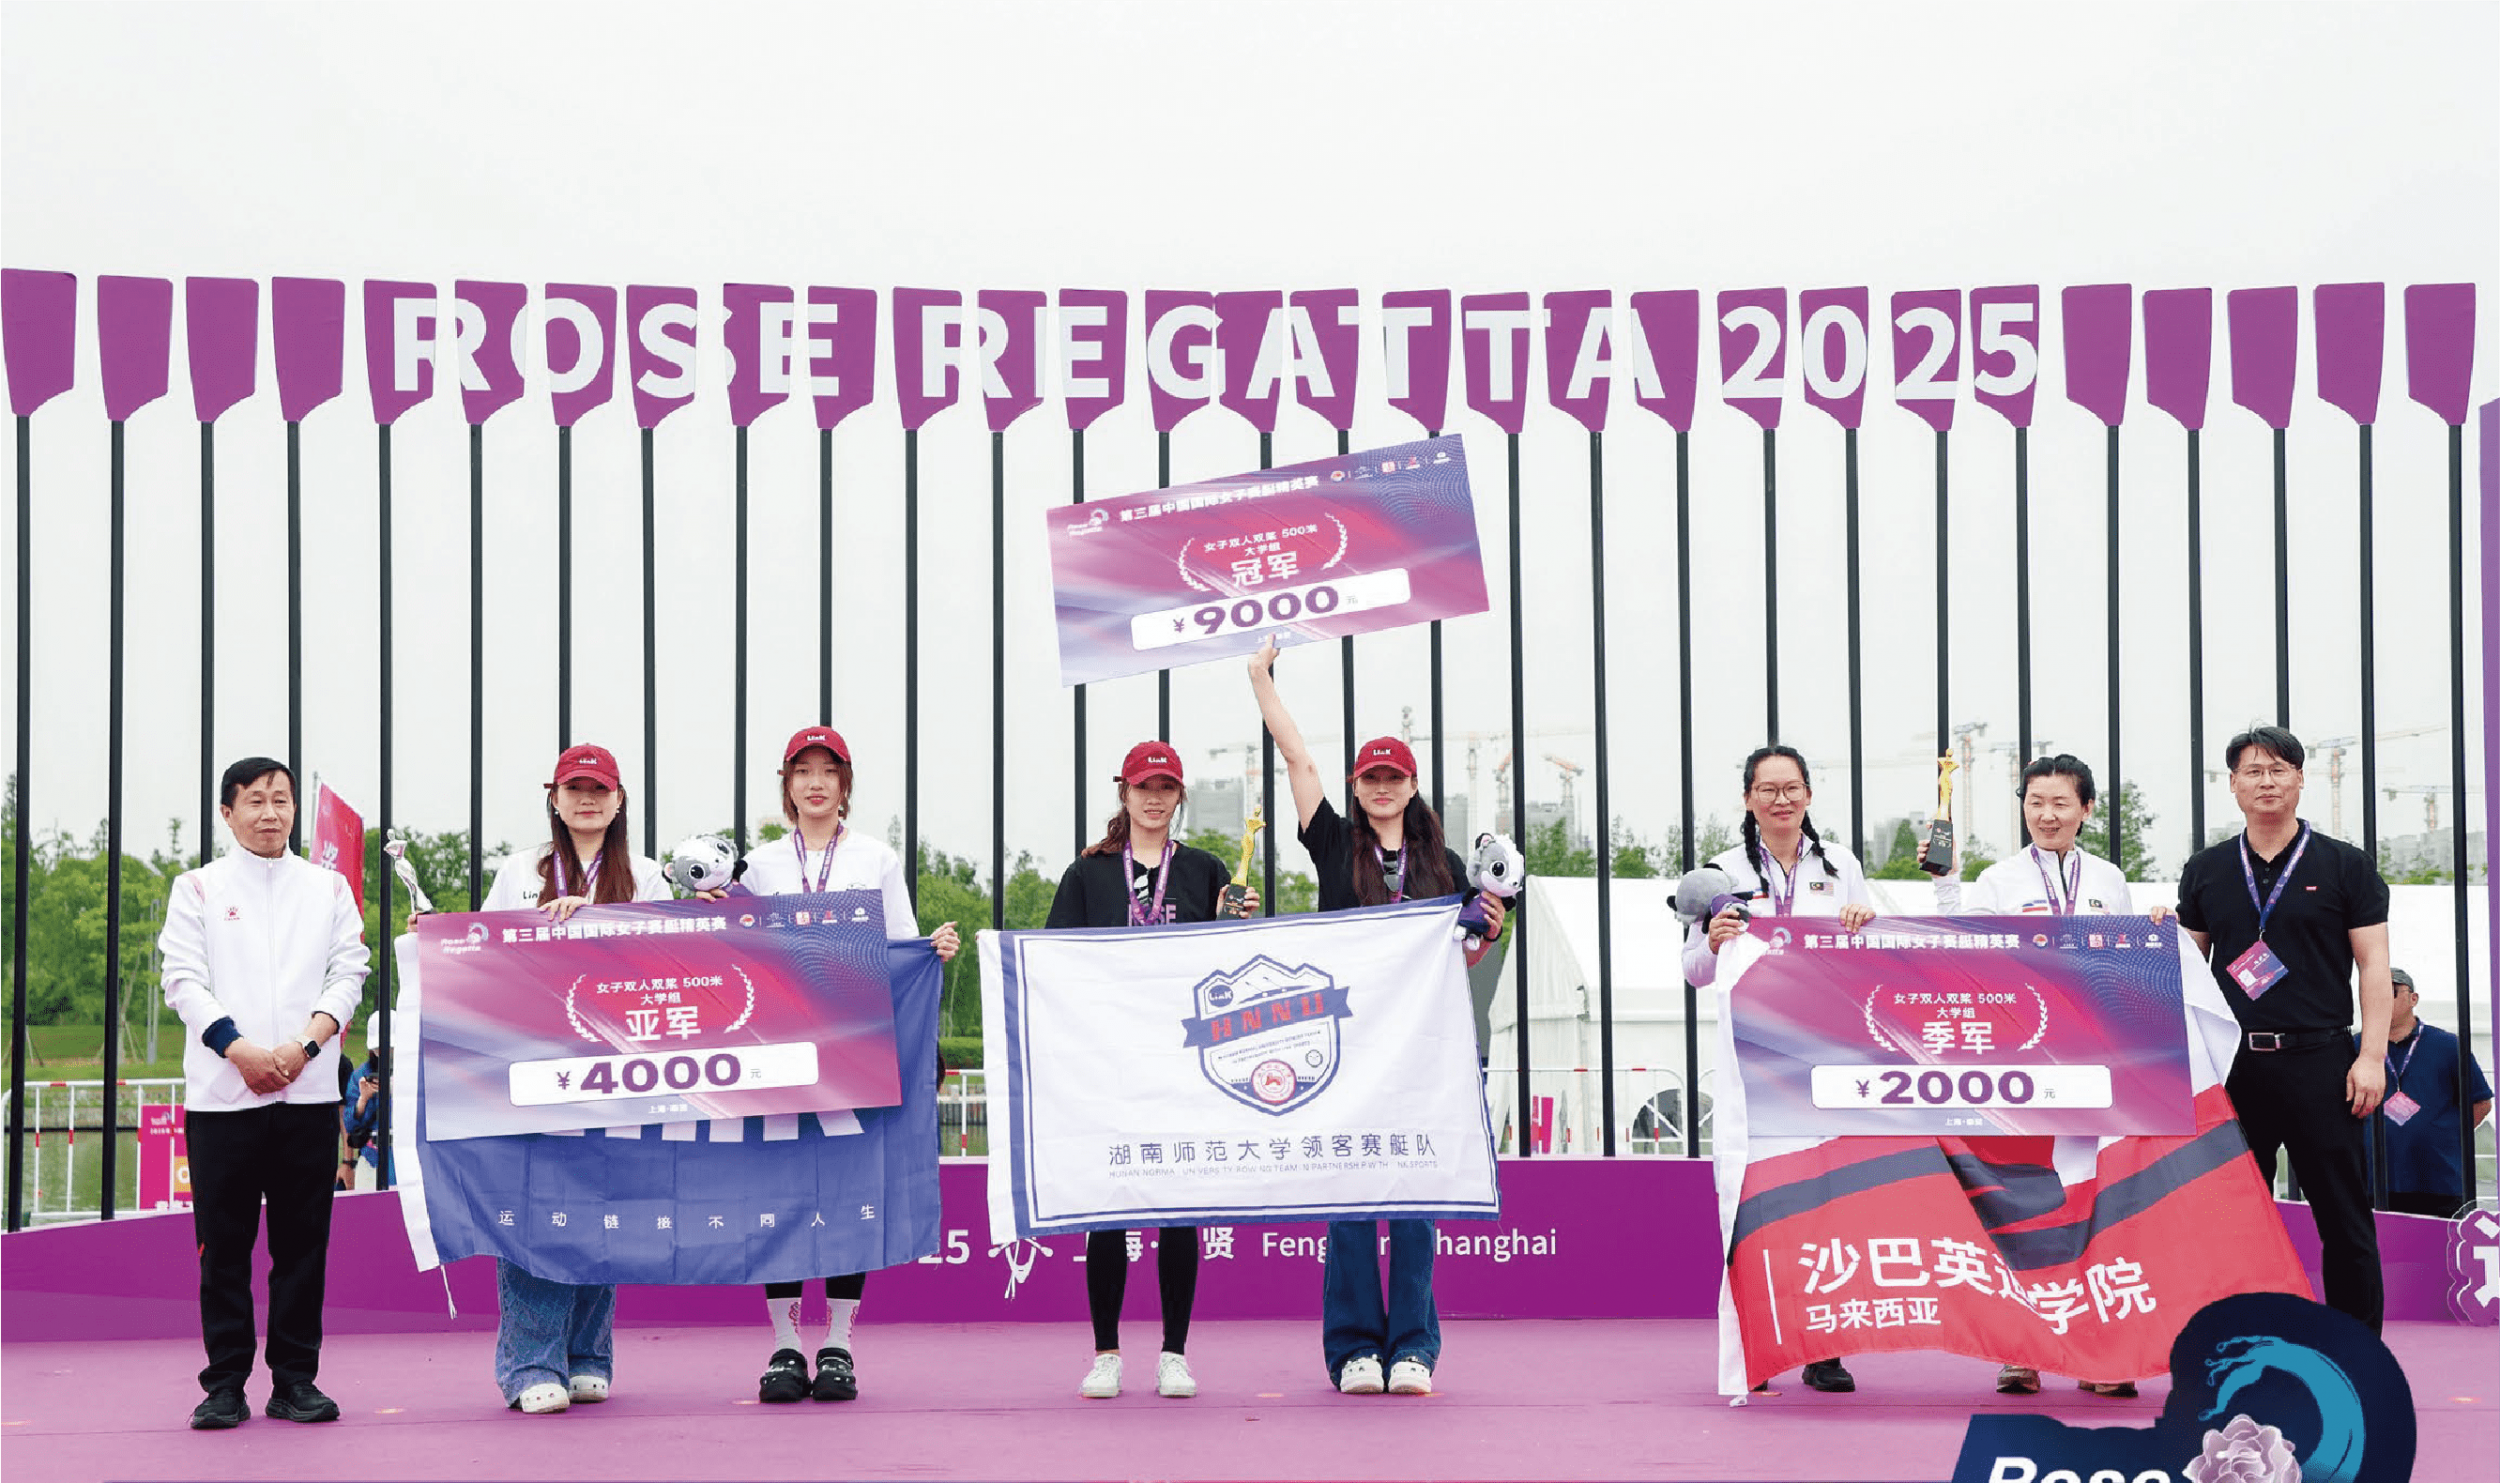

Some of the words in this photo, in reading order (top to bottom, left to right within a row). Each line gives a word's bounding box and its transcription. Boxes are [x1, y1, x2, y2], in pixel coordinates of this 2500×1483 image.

[393, 297, 840, 398] ROSE
[921, 303, 1667, 401] REGATTA
[1721, 301, 2039, 401] 2025
[1281, 524, 1318, 538] 500米
[1230, 551, 1300, 588] 冠军
[1193, 586, 1339, 635] 9000
[597, 978, 678, 994] 女子双人双桨
[683, 975, 723, 987] 500米
[640, 992, 681, 1006] 大学组
[1894, 992, 1973, 1005] 女子双人双桨
[1978, 992, 2017, 1004] 500米
[625, 1006, 702, 1042] 亚军
[1210, 992, 1325, 1042] HNNU
[1936, 1006, 1976, 1019] 大学组
[1922, 1020, 1995, 1055] 季军
[580, 1053, 741, 1094] 4000
[1879, 1070, 2034, 1105] 2000
[1109, 1132, 1436, 1166] 湖南师范大学领客赛艇队
[498, 1204, 876, 1232] 运动链接不同人生
[1435, 1228, 1557, 1263] hanghai
[1805, 1297, 1942, 1334] 马来西亚
